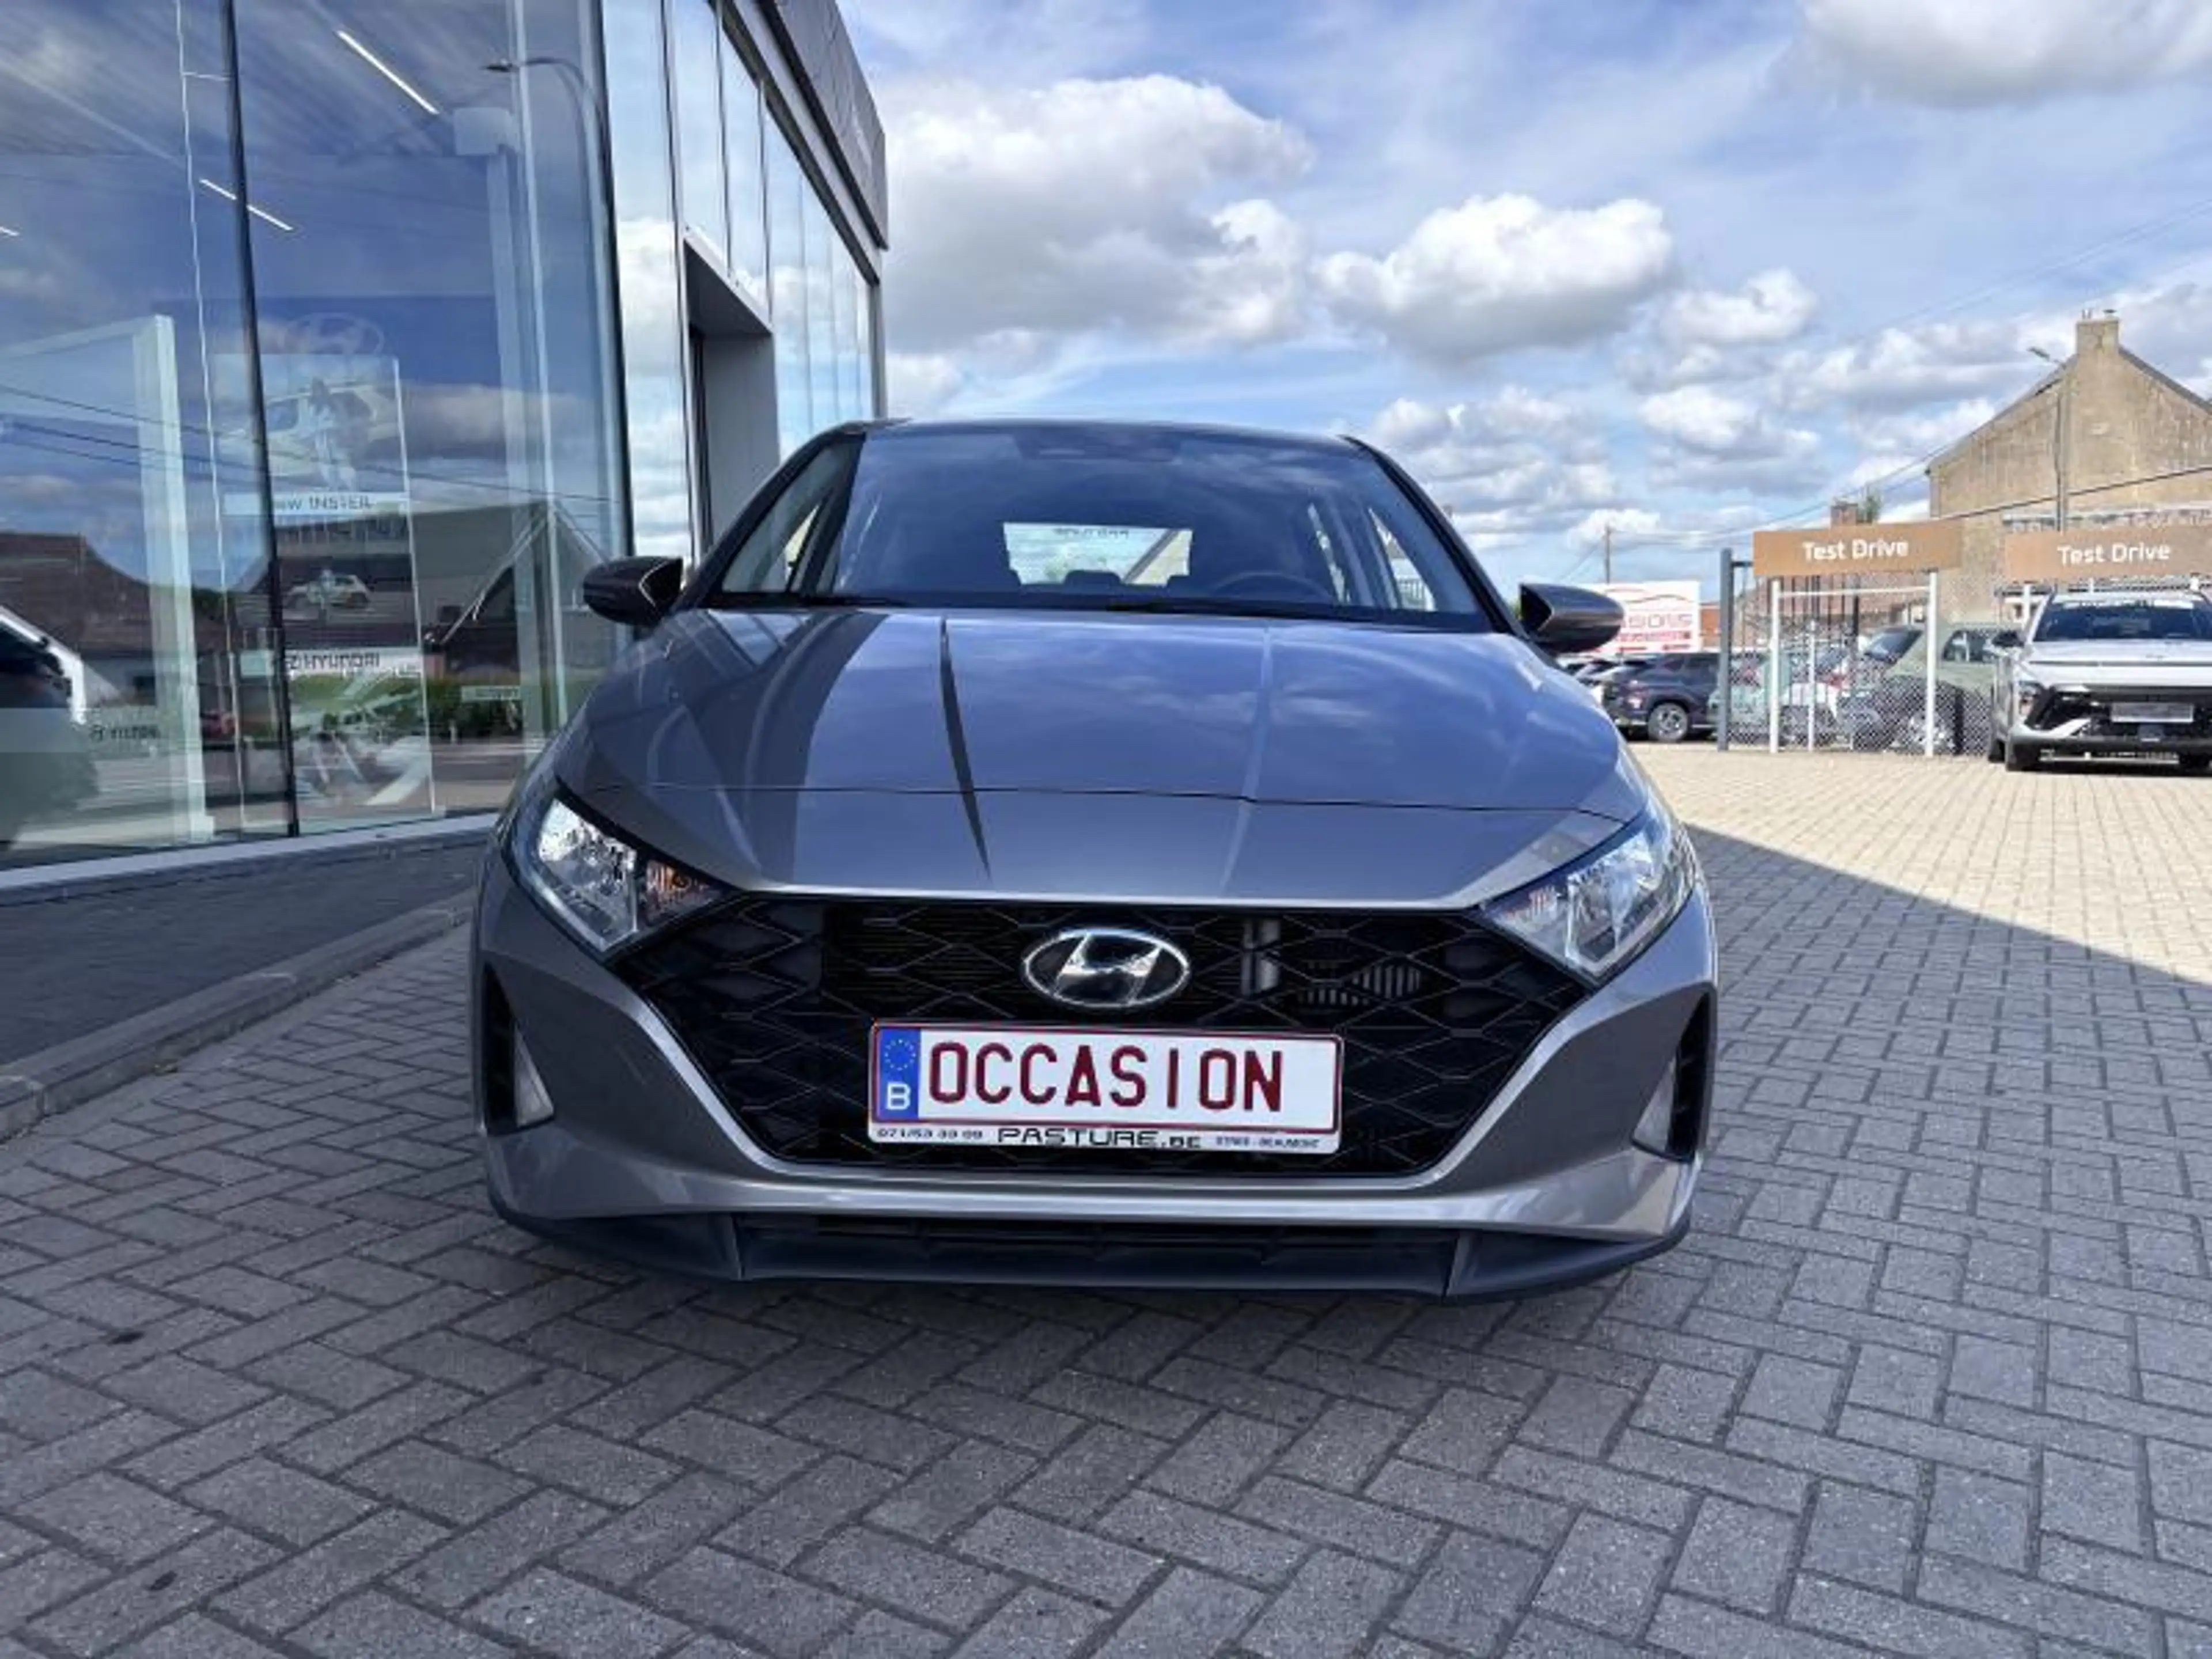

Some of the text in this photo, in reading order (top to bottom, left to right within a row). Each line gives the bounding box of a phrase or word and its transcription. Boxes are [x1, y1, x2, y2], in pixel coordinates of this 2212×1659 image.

[1802, 538, 1908, 563] Test Drive
[2057, 541, 2171, 567] Test Drive
[928, 1042, 1283, 1112] OCCASION
[885, 1082, 912, 1110] B
